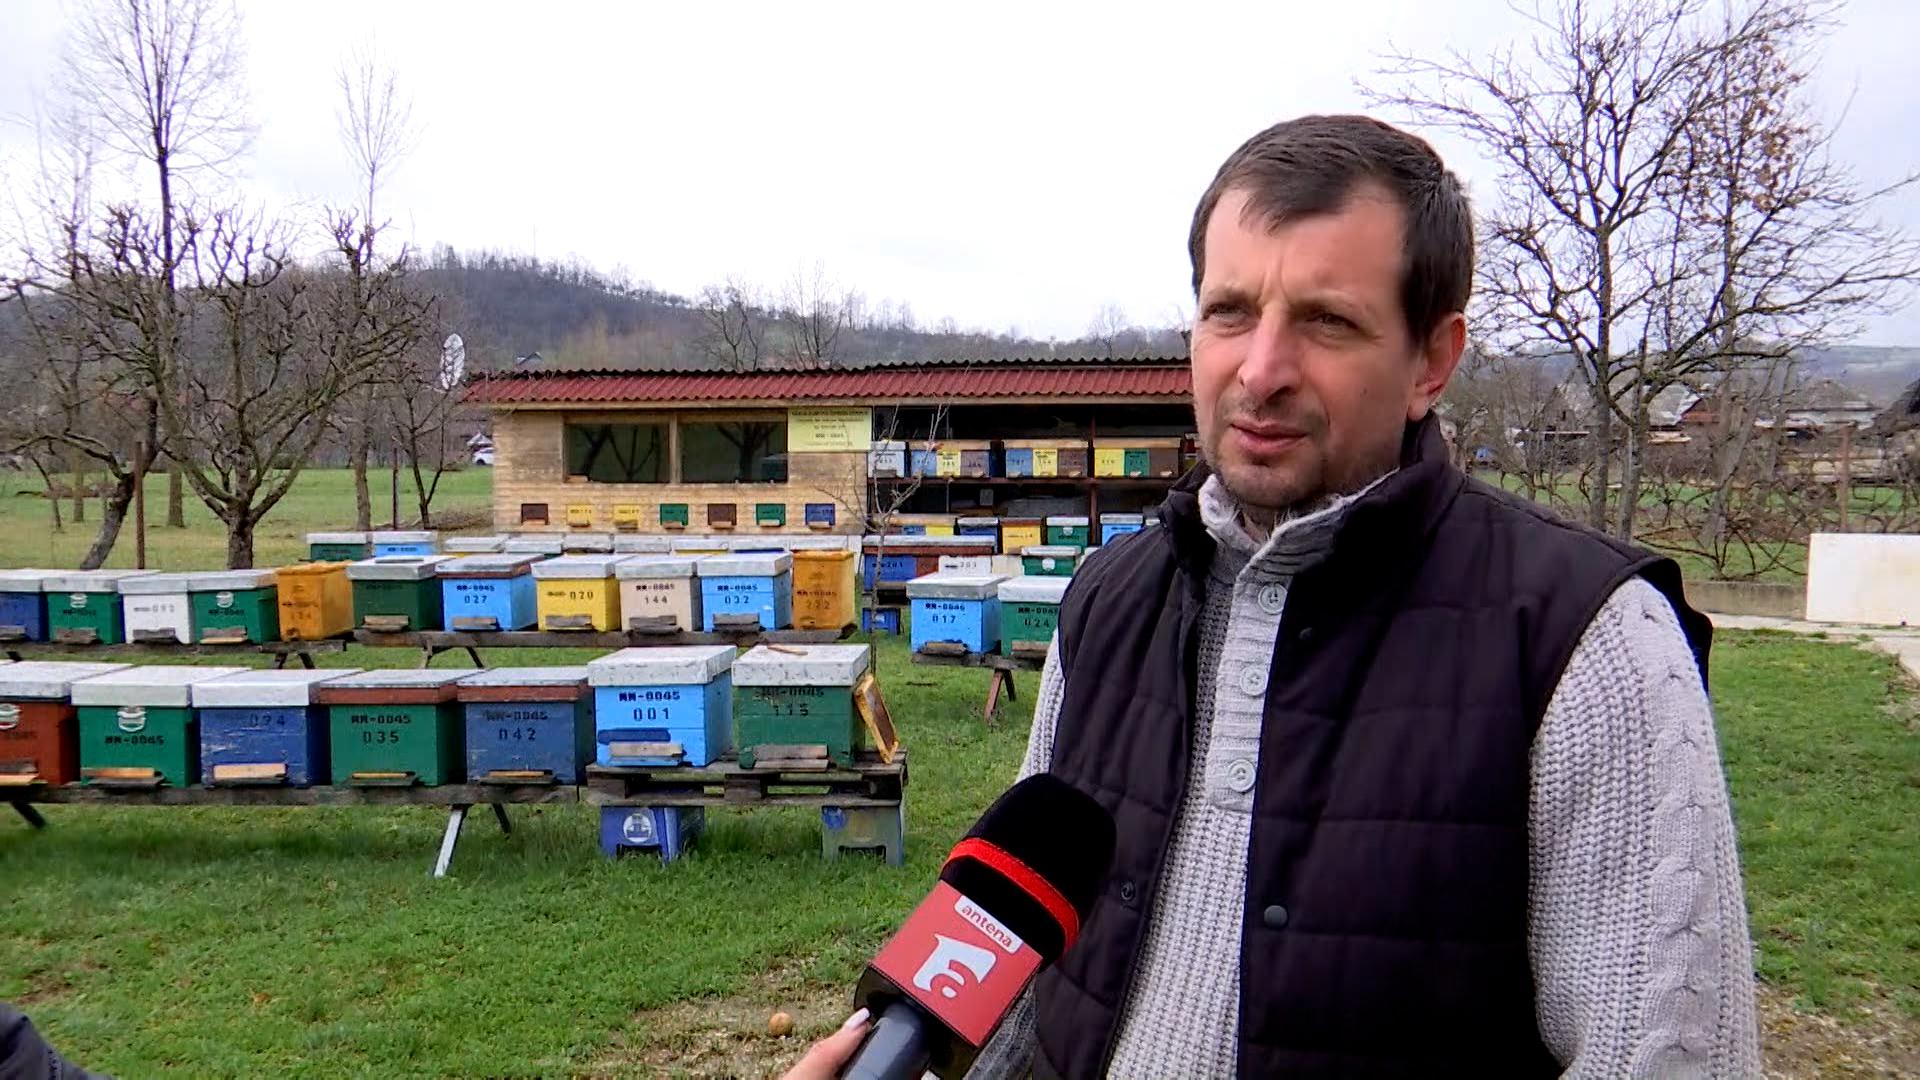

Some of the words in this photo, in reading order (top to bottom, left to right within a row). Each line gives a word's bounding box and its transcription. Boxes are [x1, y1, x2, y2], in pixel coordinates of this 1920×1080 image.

[464, 595, 487, 604] 027
[570, 591, 594, 600] 020
[645, 595, 668, 604] 144
[725, 595, 750, 604] 032
[932, 615, 956, 624] 017
[1024, 618, 1050, 628] 024
[633, 707, 670, 722] 001
[363, 730, 400, 744] 035
[498, 727, 537, 741] 042
[961, 903, 1013, 948] antena
